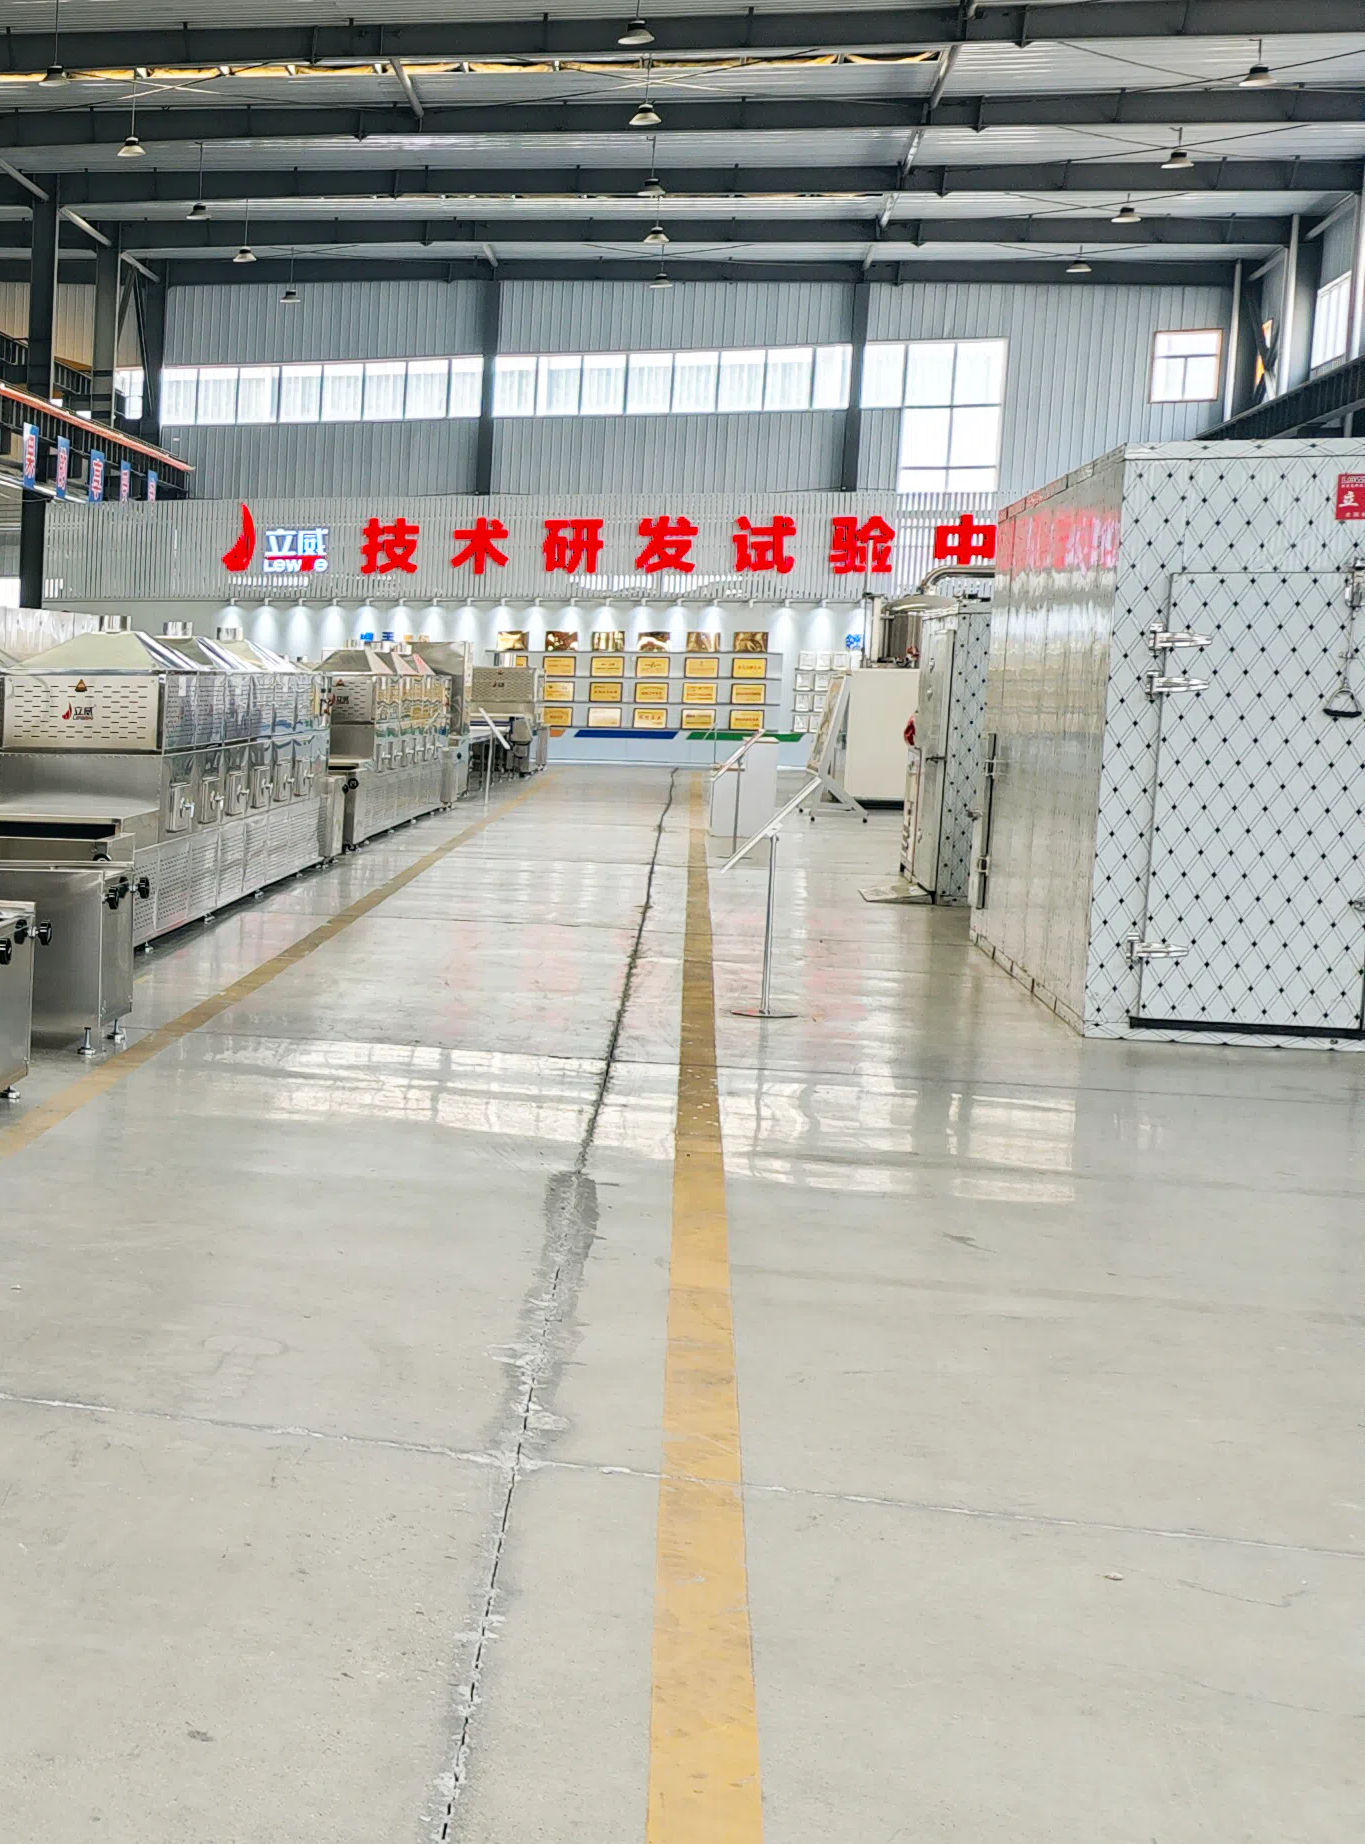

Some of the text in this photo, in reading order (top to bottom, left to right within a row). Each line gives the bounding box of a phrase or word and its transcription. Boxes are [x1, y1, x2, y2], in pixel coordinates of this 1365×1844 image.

[264, 528, 330, 557] 立威
[361, 514, 997, 575] 技术研发试验中
